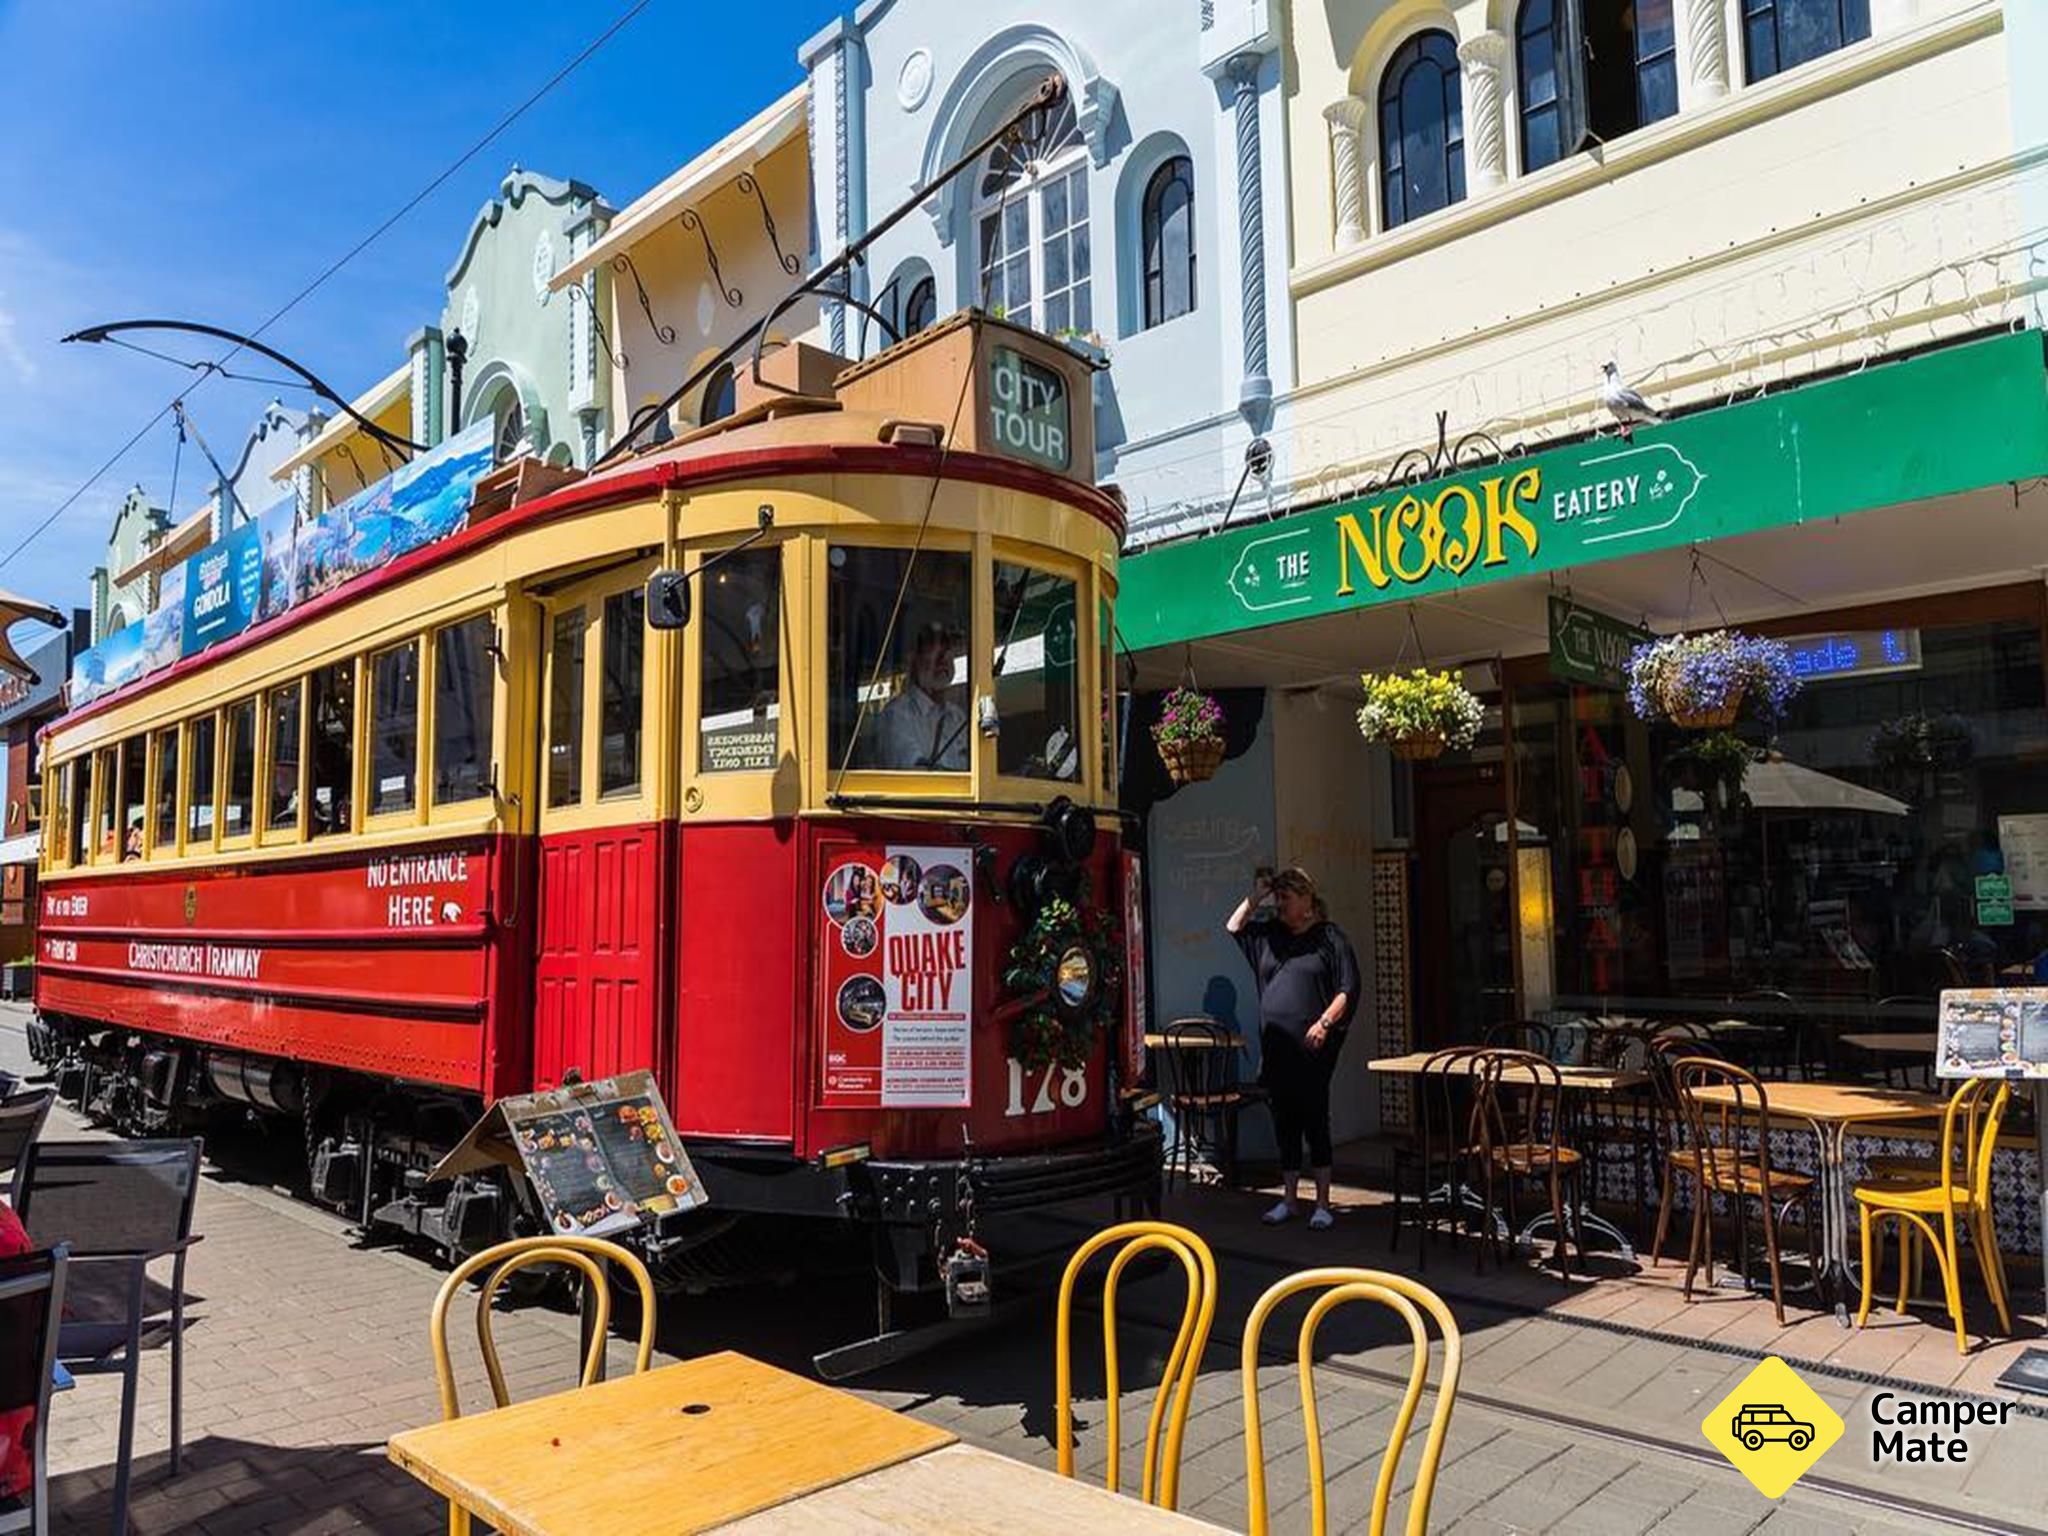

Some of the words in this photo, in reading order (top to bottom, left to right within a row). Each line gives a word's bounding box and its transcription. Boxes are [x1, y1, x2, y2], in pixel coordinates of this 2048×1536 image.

[994, 366, 1055, 415] CITY
[990, 406, 1064, 461] TOUR
[1277, 549, 1310, 580] THE
[1335, 467, 1541, 597] NOOK
[1553, 474, 1641, 522] EATERY
[1793, 638, 1856, 673] ade
[367, 858, 388, 889] NO
[389, 850, 468, 886] ENTRANCE
[388, 894, 435, 927] HERE
[128, 942, 202, 974] CHRISTCHURCH
[206, 942, 262, 979] TRAMWAY
[888, 929, 966, 979] QUAKE
[902, 971, 953, 1011] CITY
[1005, 1057, 1088, 1117] 178
